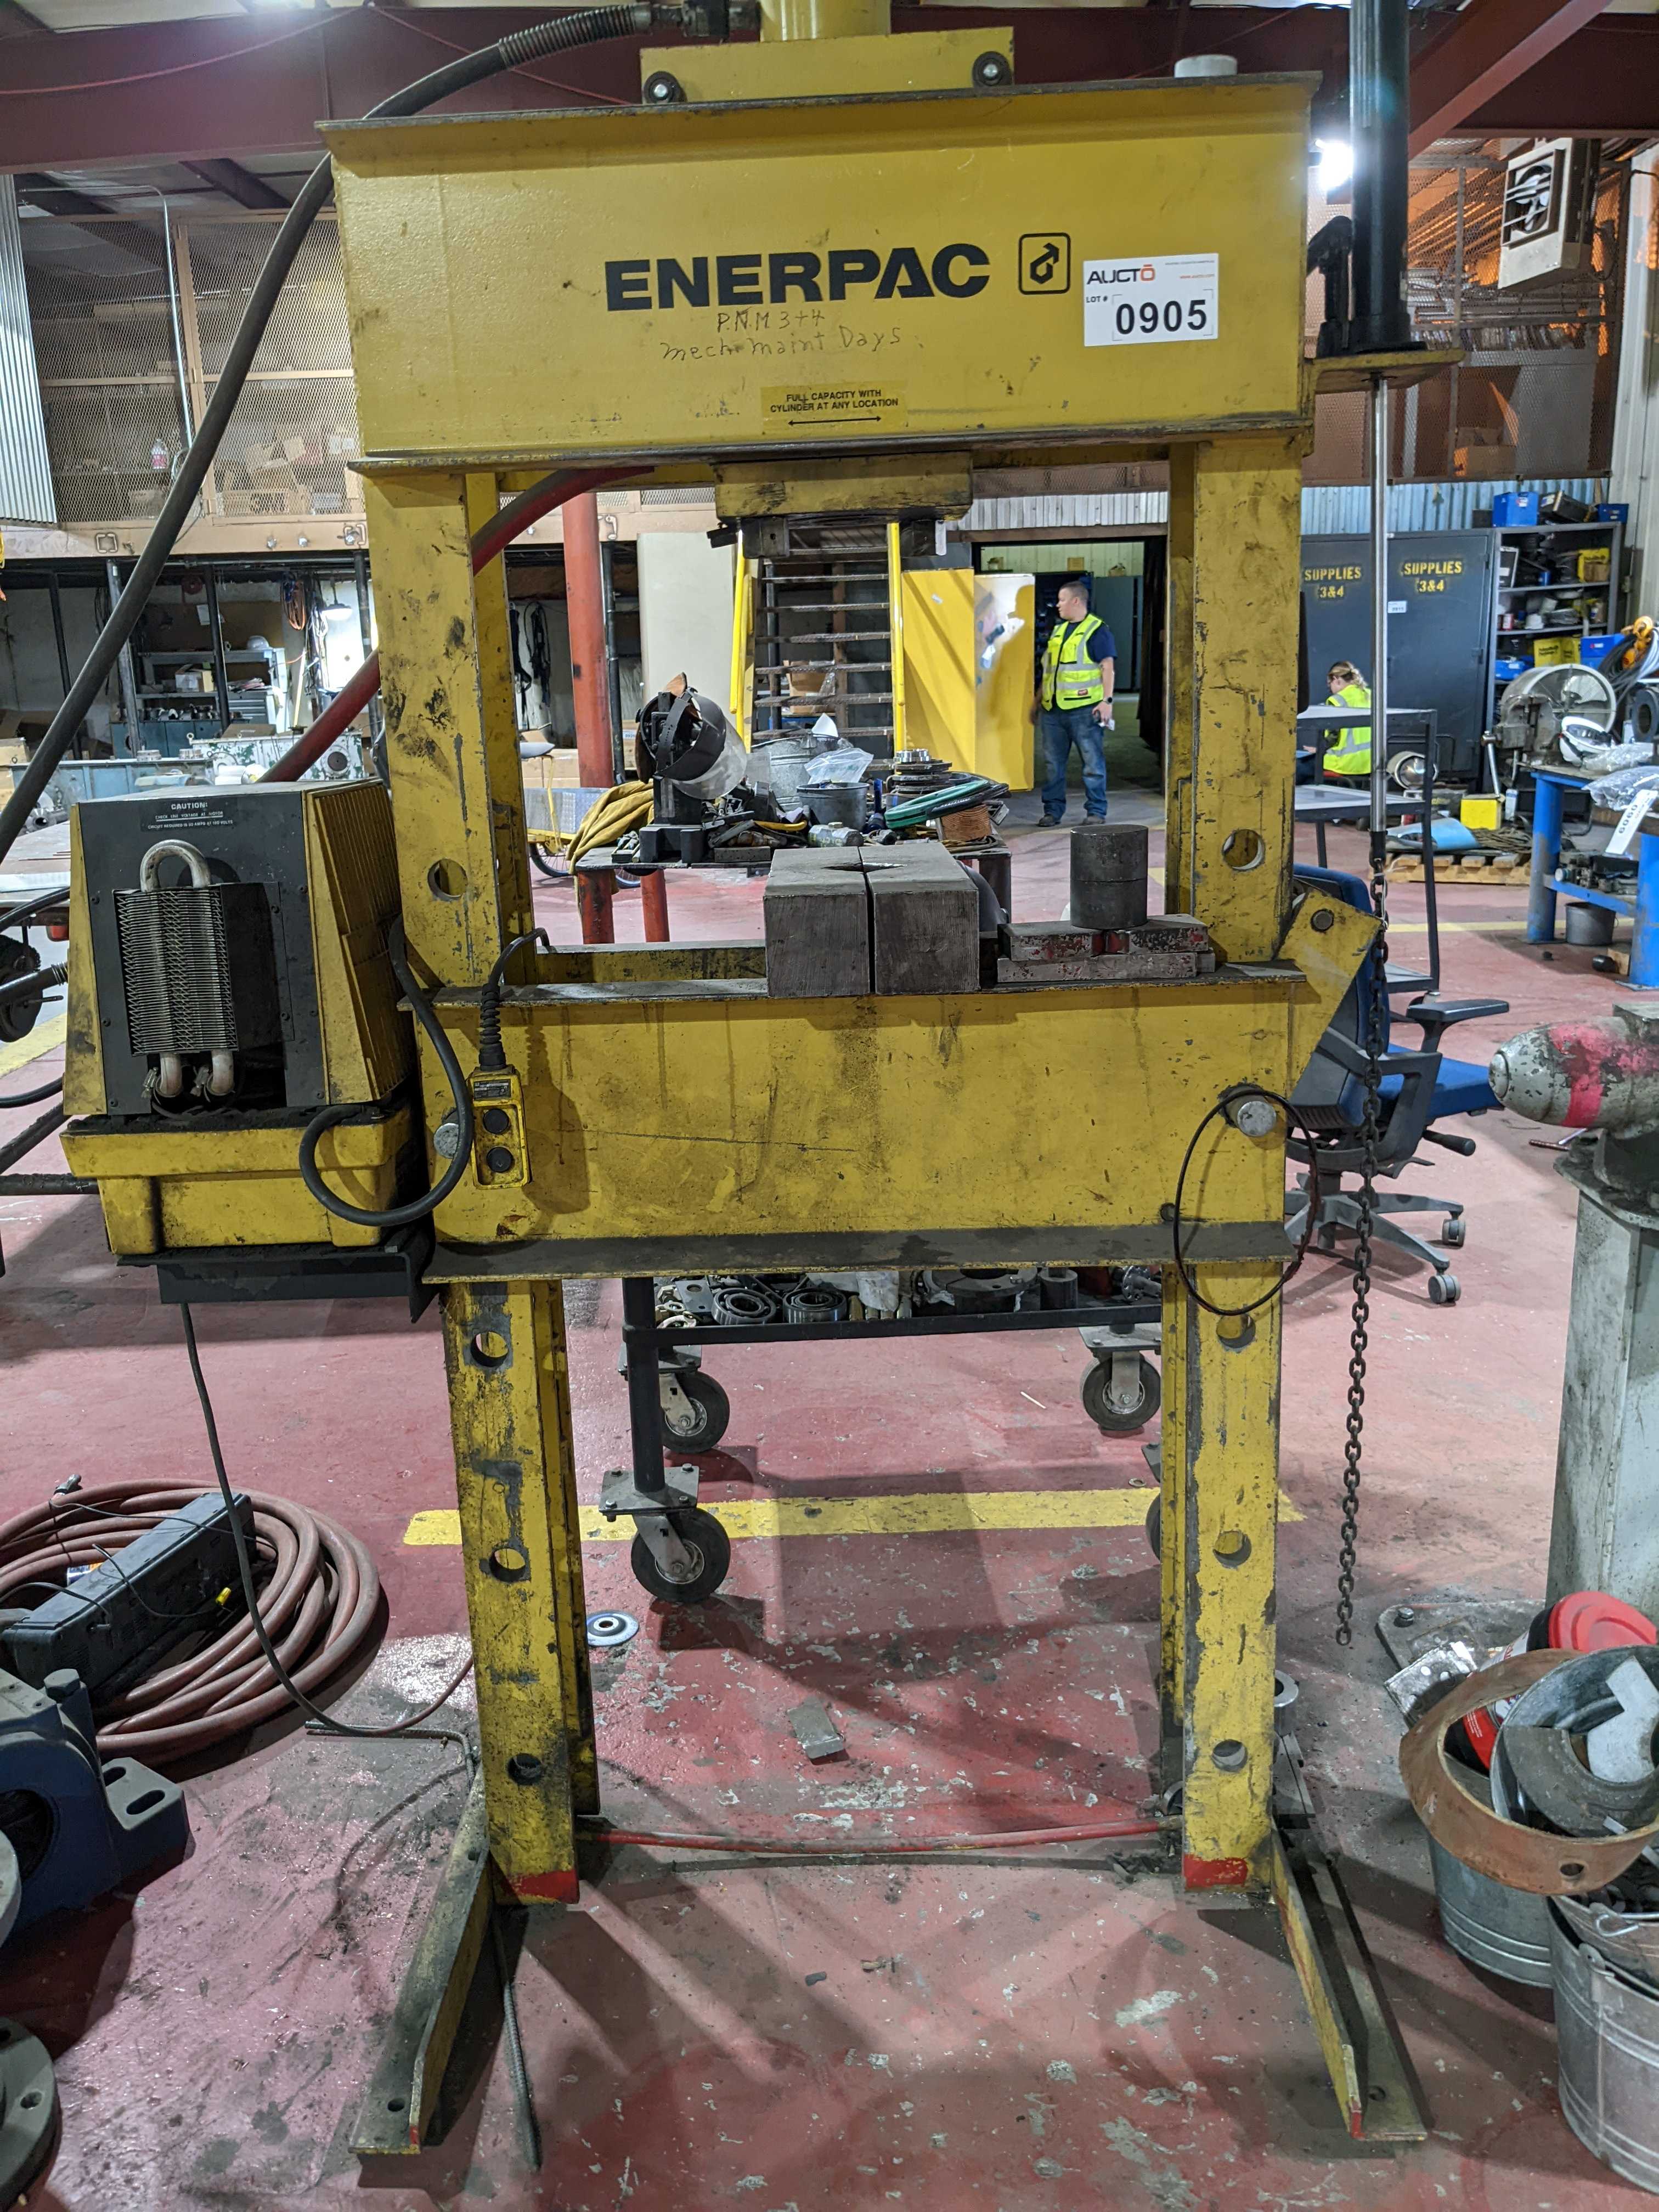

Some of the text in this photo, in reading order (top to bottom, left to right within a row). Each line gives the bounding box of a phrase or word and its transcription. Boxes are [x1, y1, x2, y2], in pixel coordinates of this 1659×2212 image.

[605, 244, 990, 311] ENERPAC
[1086, 295, 1101, 303] LOT
[1116, 299, 1207, 335] 0905
[786, 389, 882, 402] FULL CAPACITY WITH
[770, 398, 899, 413] CYLINDER AT ANY LOCATION
[1304, 566, 1362, 581] SUPPLIES
[1403, 561, 1462, 575] SUPPLIES
[1319, 585, 1344, 599] 3&4
[1419, 579, 1444, 592] 3&4
[171, 802, 208, 810] CAUTION:
